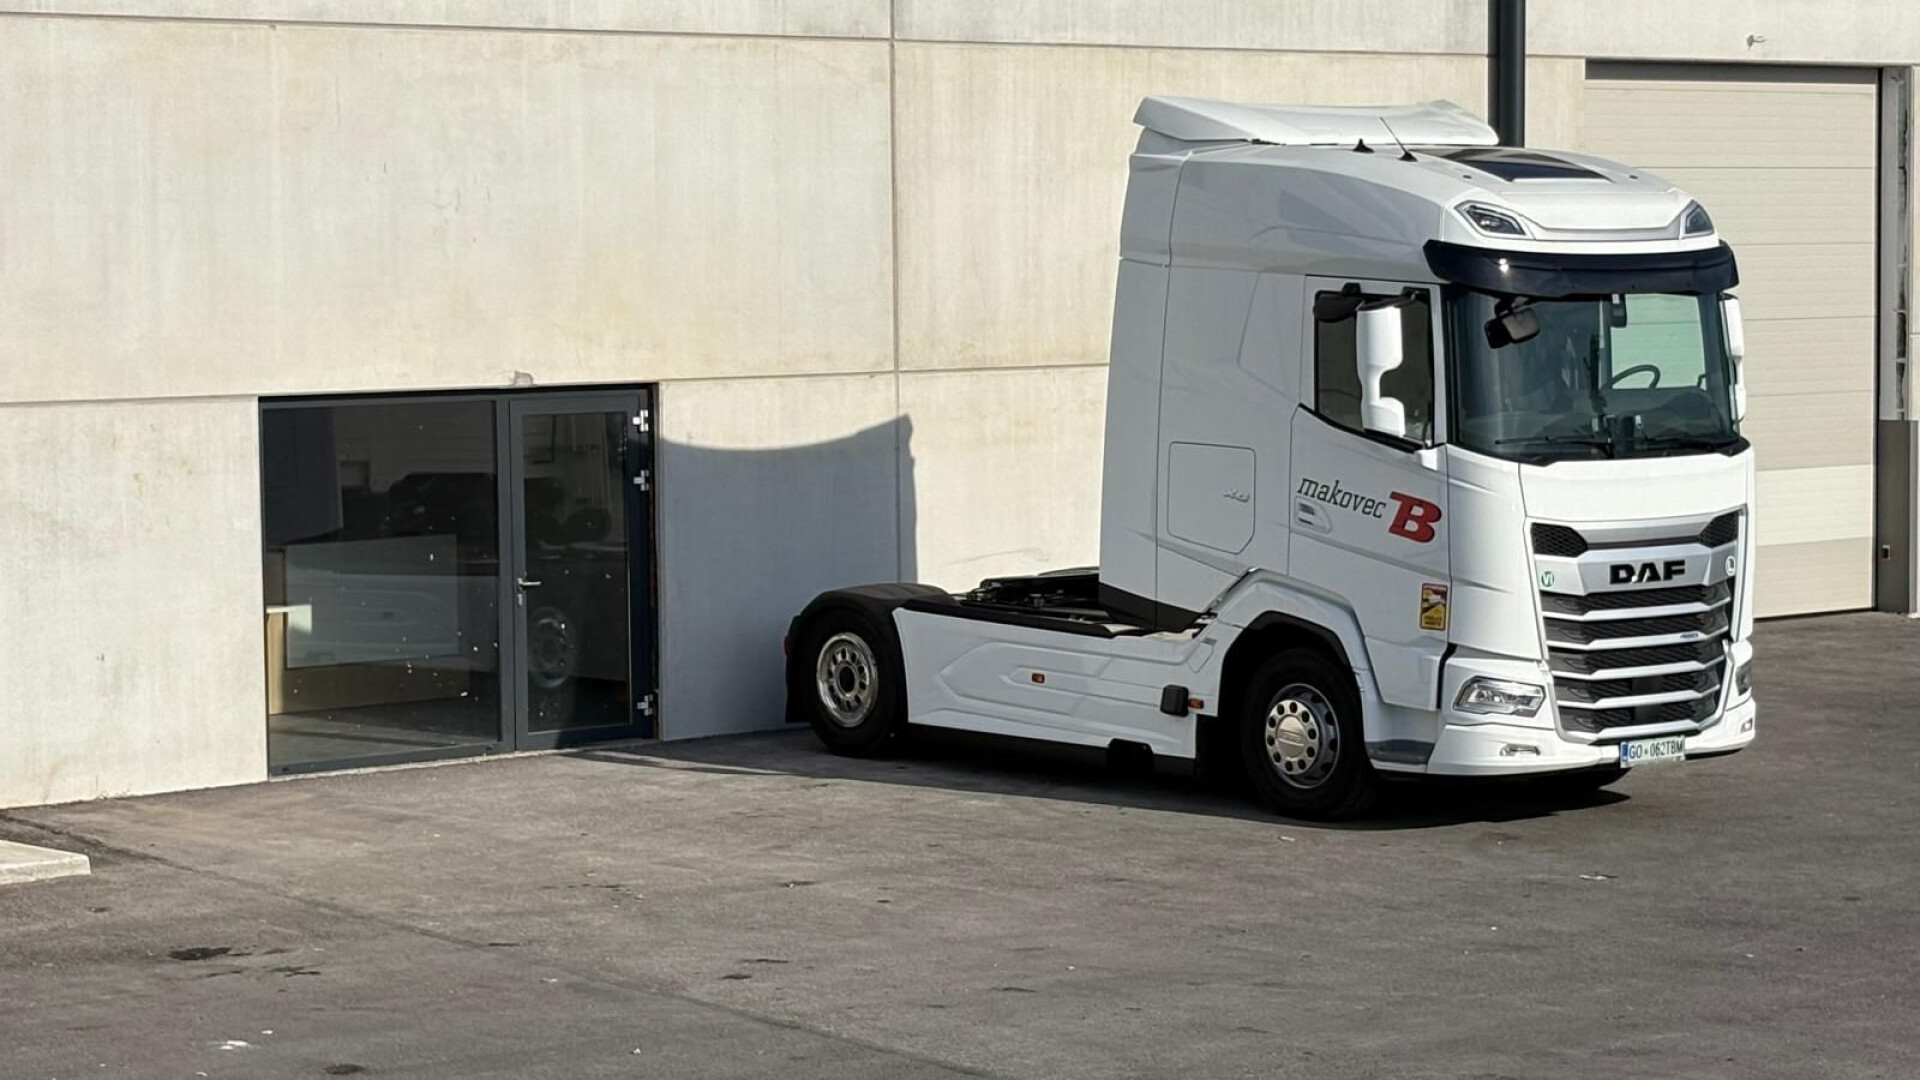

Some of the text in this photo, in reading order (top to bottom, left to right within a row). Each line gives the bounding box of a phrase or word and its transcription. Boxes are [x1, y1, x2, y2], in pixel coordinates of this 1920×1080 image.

[1297, 478, 1442, 544] makovec B
[1609, 559, 1686, 585] DAF
